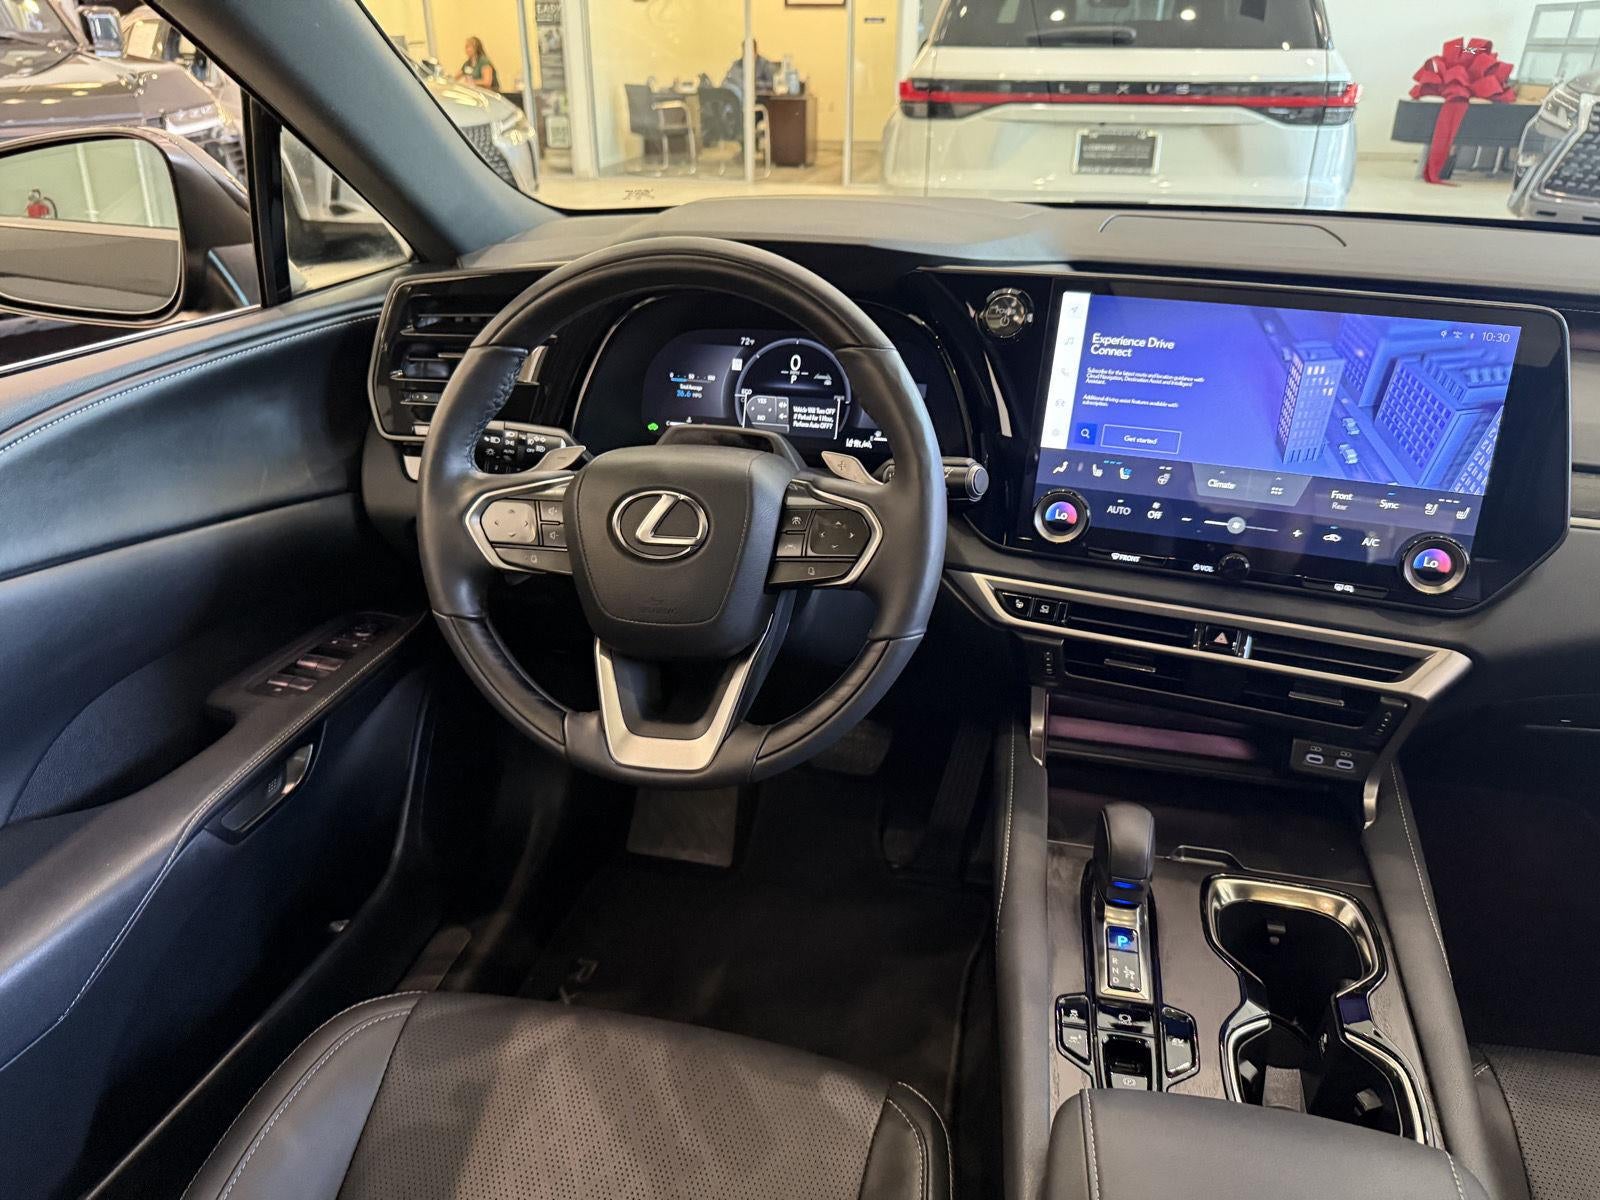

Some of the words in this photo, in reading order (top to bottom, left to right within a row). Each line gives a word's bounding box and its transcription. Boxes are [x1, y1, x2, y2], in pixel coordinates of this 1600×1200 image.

[1059, 83, 1190, 95] LEXUS
[1092, 332, 1147, 349] Experience
[1147, 336, 1175, 350] Drive
[1482, 331, 1511, 343] 10:30
[1090, 344, 1133, 358] Connect
[789, 354, 802, 371] 0
[790, 374, 798, 385] P
[1123, 435, 1135, 443] Get
[1136, 437, 1158, 445] started
[1207, 479, 1236, 490] Climate
[1330, 491, 1353, 501] Front
[1331, 502, 1348, 511] Rear
[1379, 499, 1399, 510] Sync
[1054, 509, 1068, 521] Lo
[1106, 505, 1132, 516] AUTO
[1147, 510, 1164, 520] Off
[1361, 537, 1381, 547] A/C
[1119, 554, 1141, 562] FRONT
[1423, 556, 1439, 568] Lo
[1200, 564, 1214, 572] VOL
[1117, 935, 1129, 947] P
[1112, 957, 1118, 965] R
[1112, 967, 1119, 975] N
